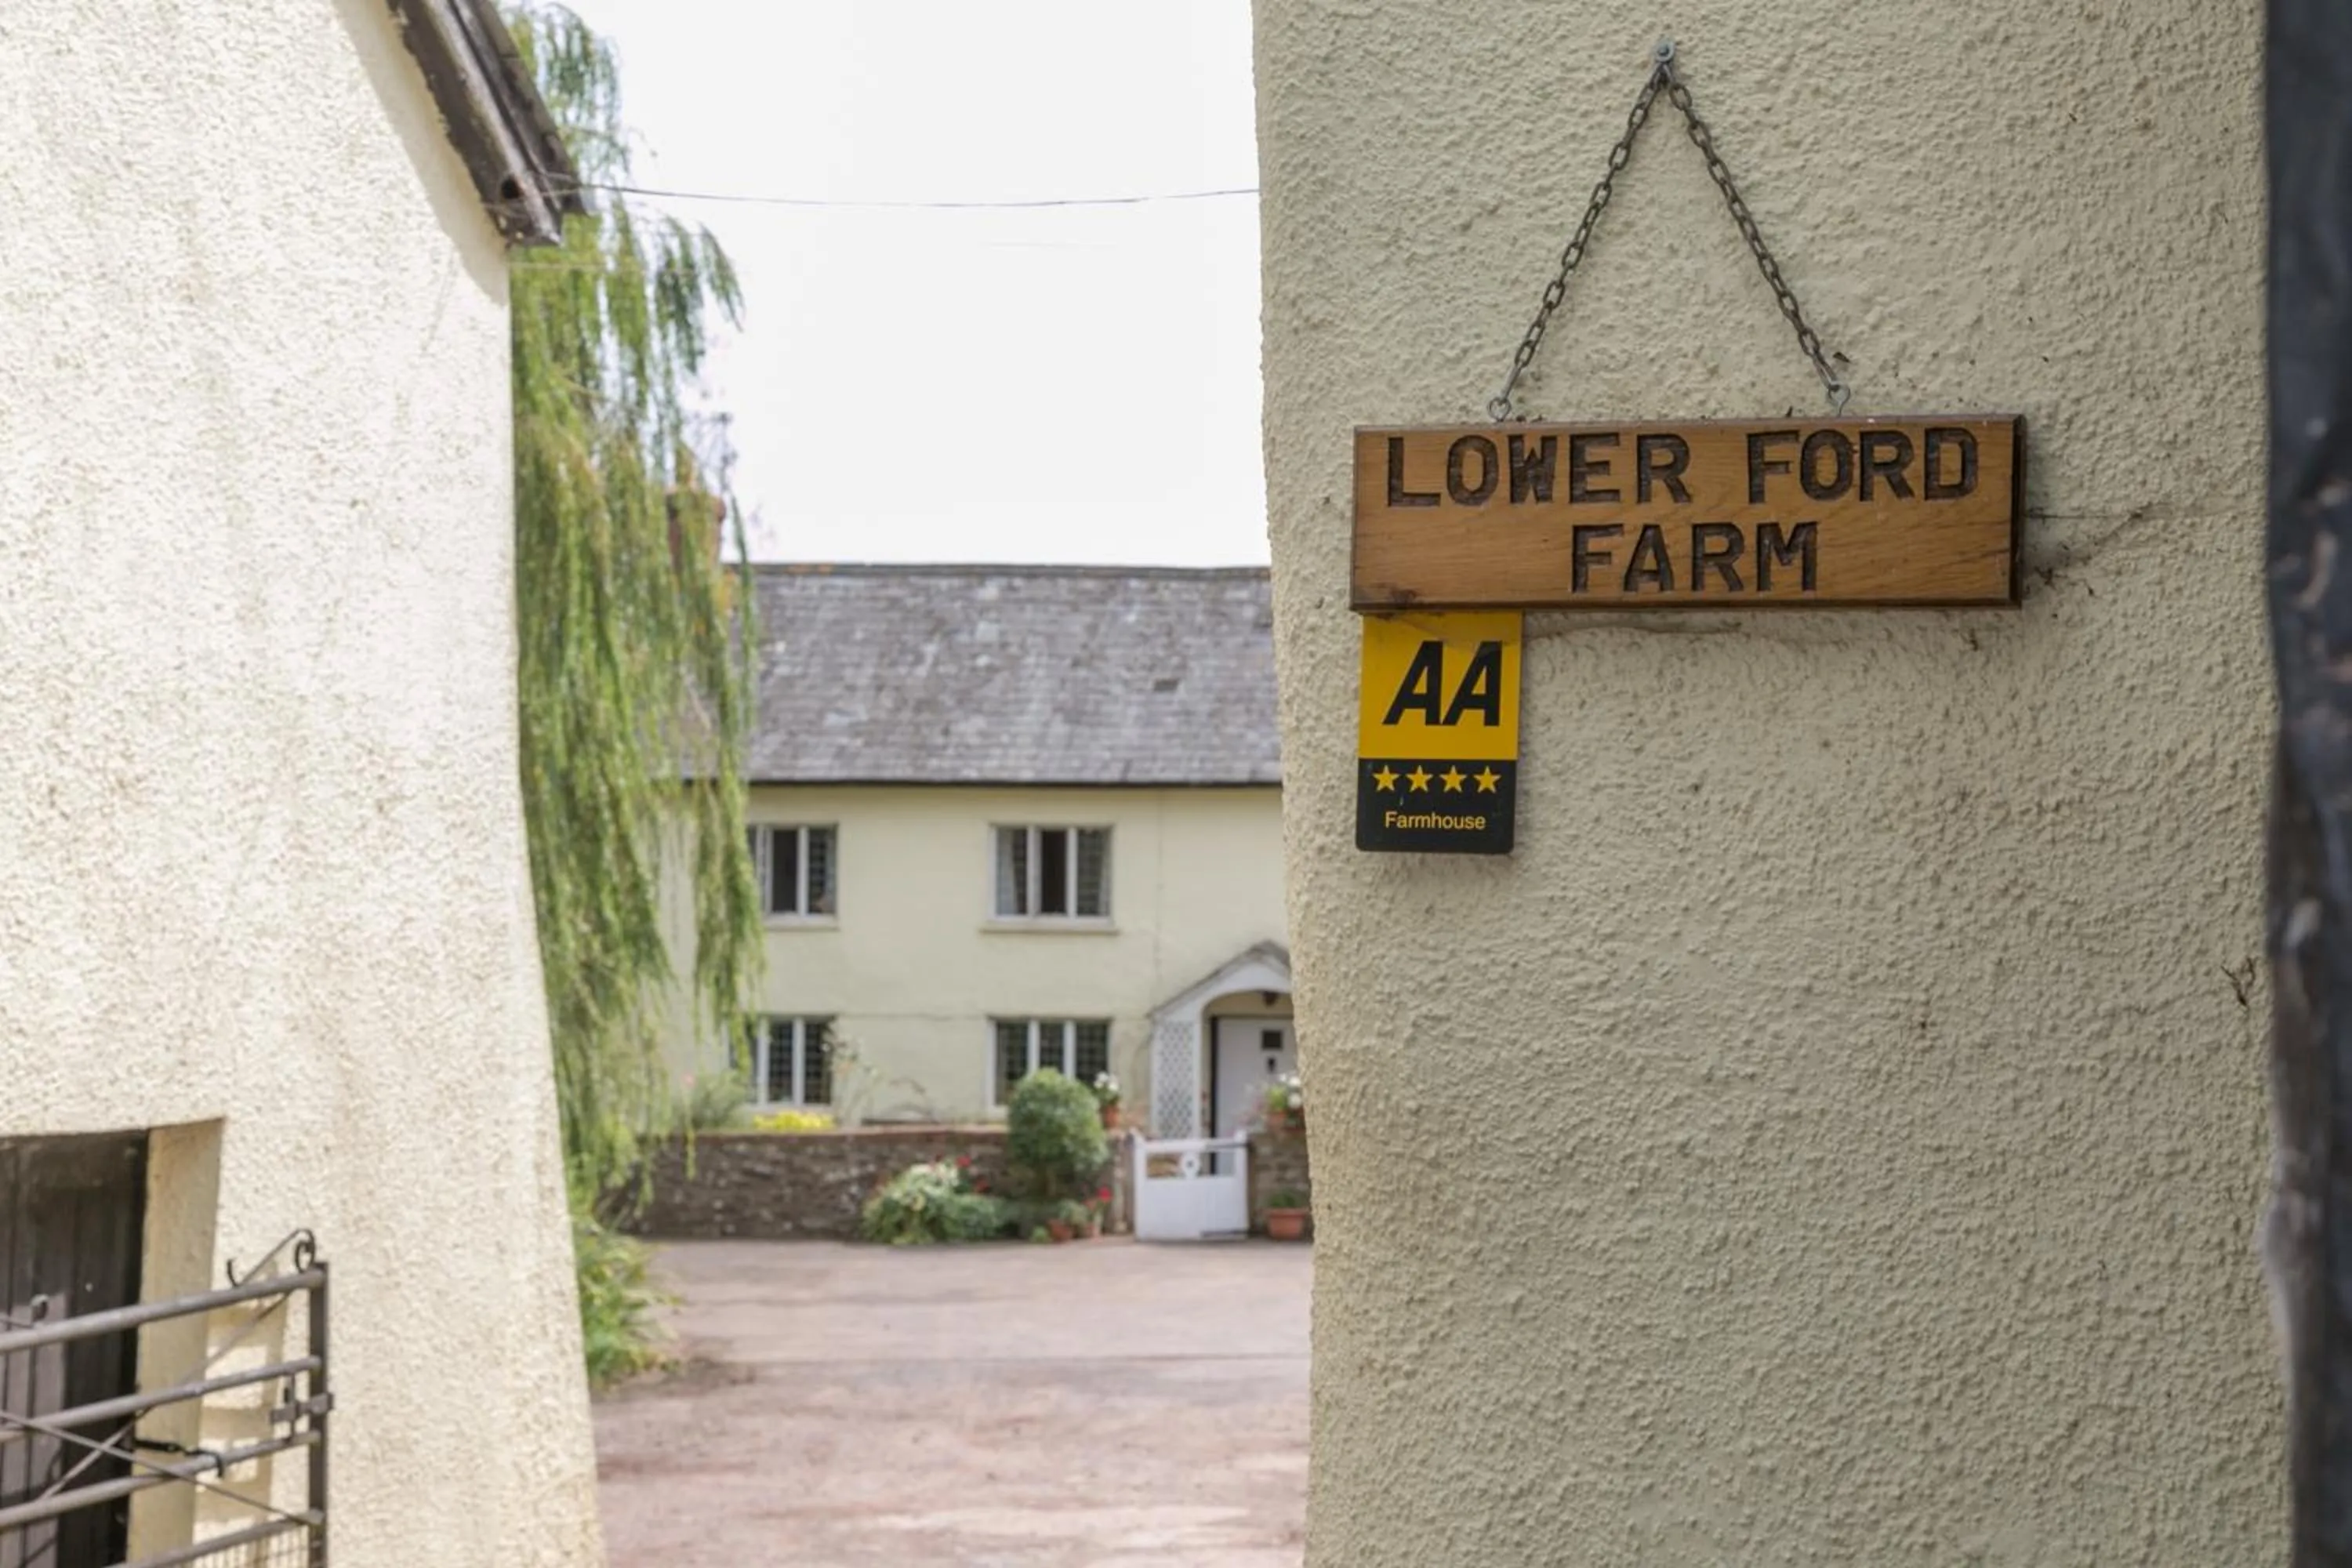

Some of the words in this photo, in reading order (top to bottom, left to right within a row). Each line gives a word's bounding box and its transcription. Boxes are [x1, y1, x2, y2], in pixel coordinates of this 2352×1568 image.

[1385, 431, 1693, 508] LOWER
[1747, 426, 1979, 503] FORD
[1572, 521, 1818, 594] FARM
[1382, 640, 1503, 726] AA
[1385, 811, 1486, 829] Farmhouse
